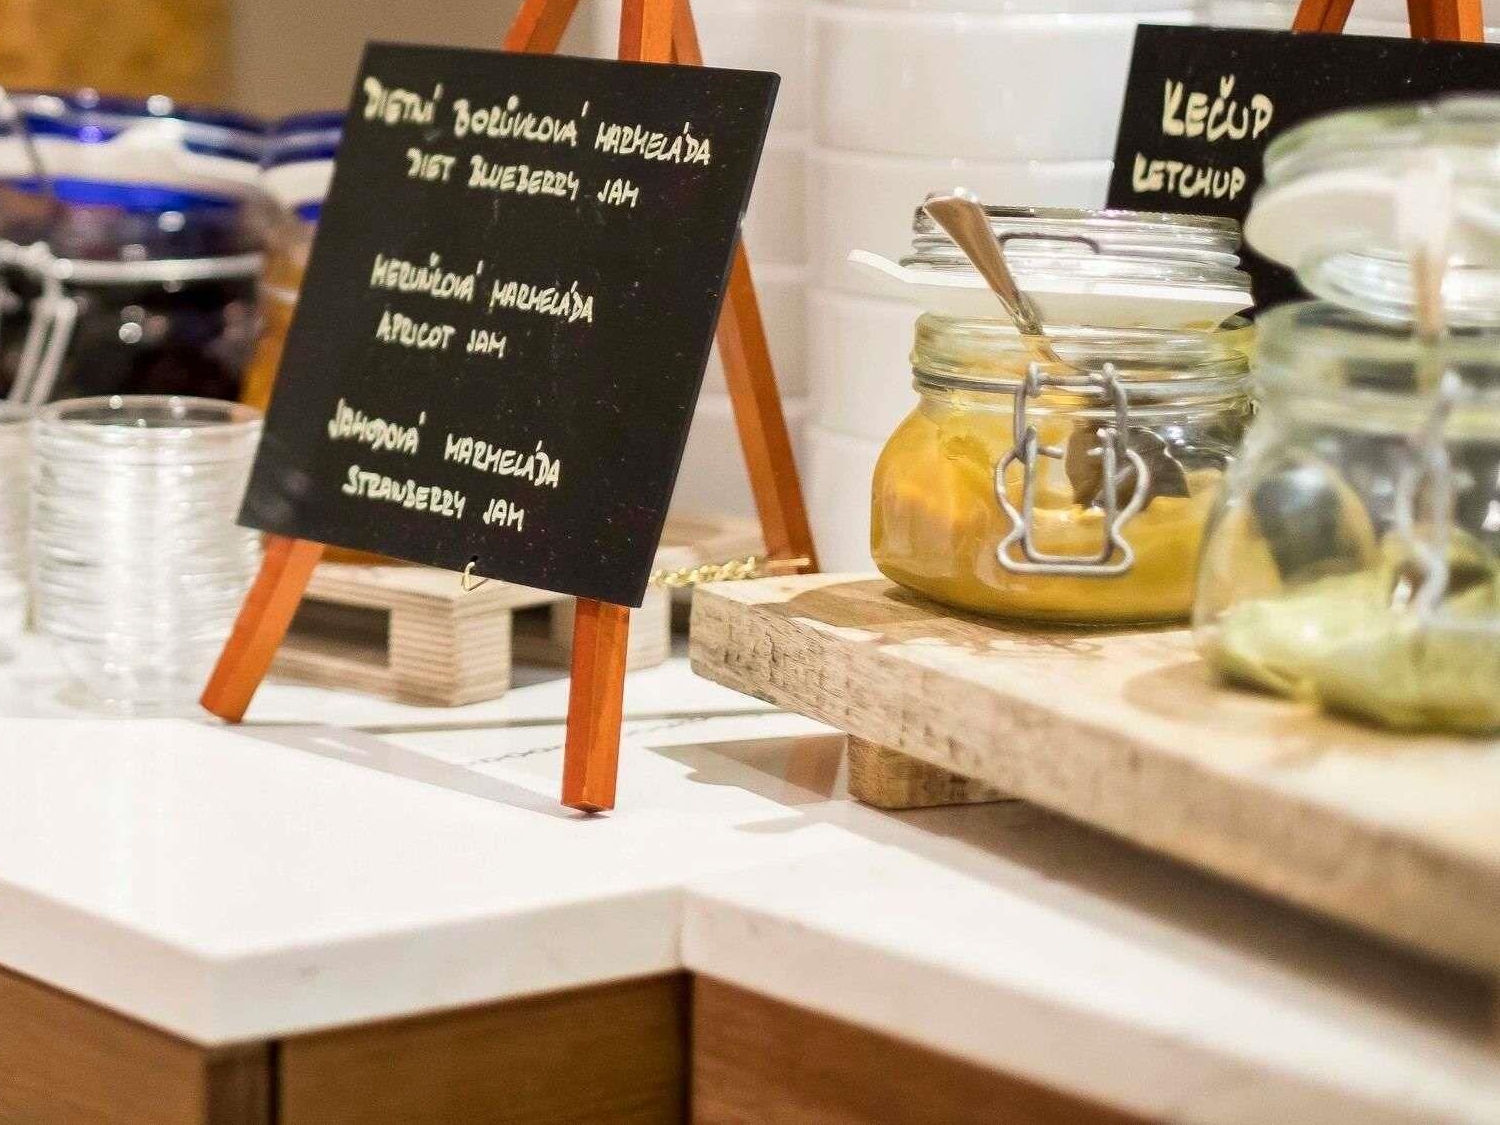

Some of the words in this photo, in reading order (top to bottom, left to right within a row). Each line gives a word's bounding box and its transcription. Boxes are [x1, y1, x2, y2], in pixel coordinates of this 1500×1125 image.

[1161, 74, 1274, 142] KEČUP
[594, 121, 711, 166] MARMELÁDA
[406, 147, 456, 181] DIET
[467, 154, 580, 202] BLUEBERRY
[596, 178, 640, 208] JAM
[488, 279, 594, 323] MARMELÁDA
[375, 310, 456, 350] APRICOT
[465, 328, 507, 359] JAM
[443, 432, 561, 489] MARMELÁDA
[482, 498, 525, 532] JAM
